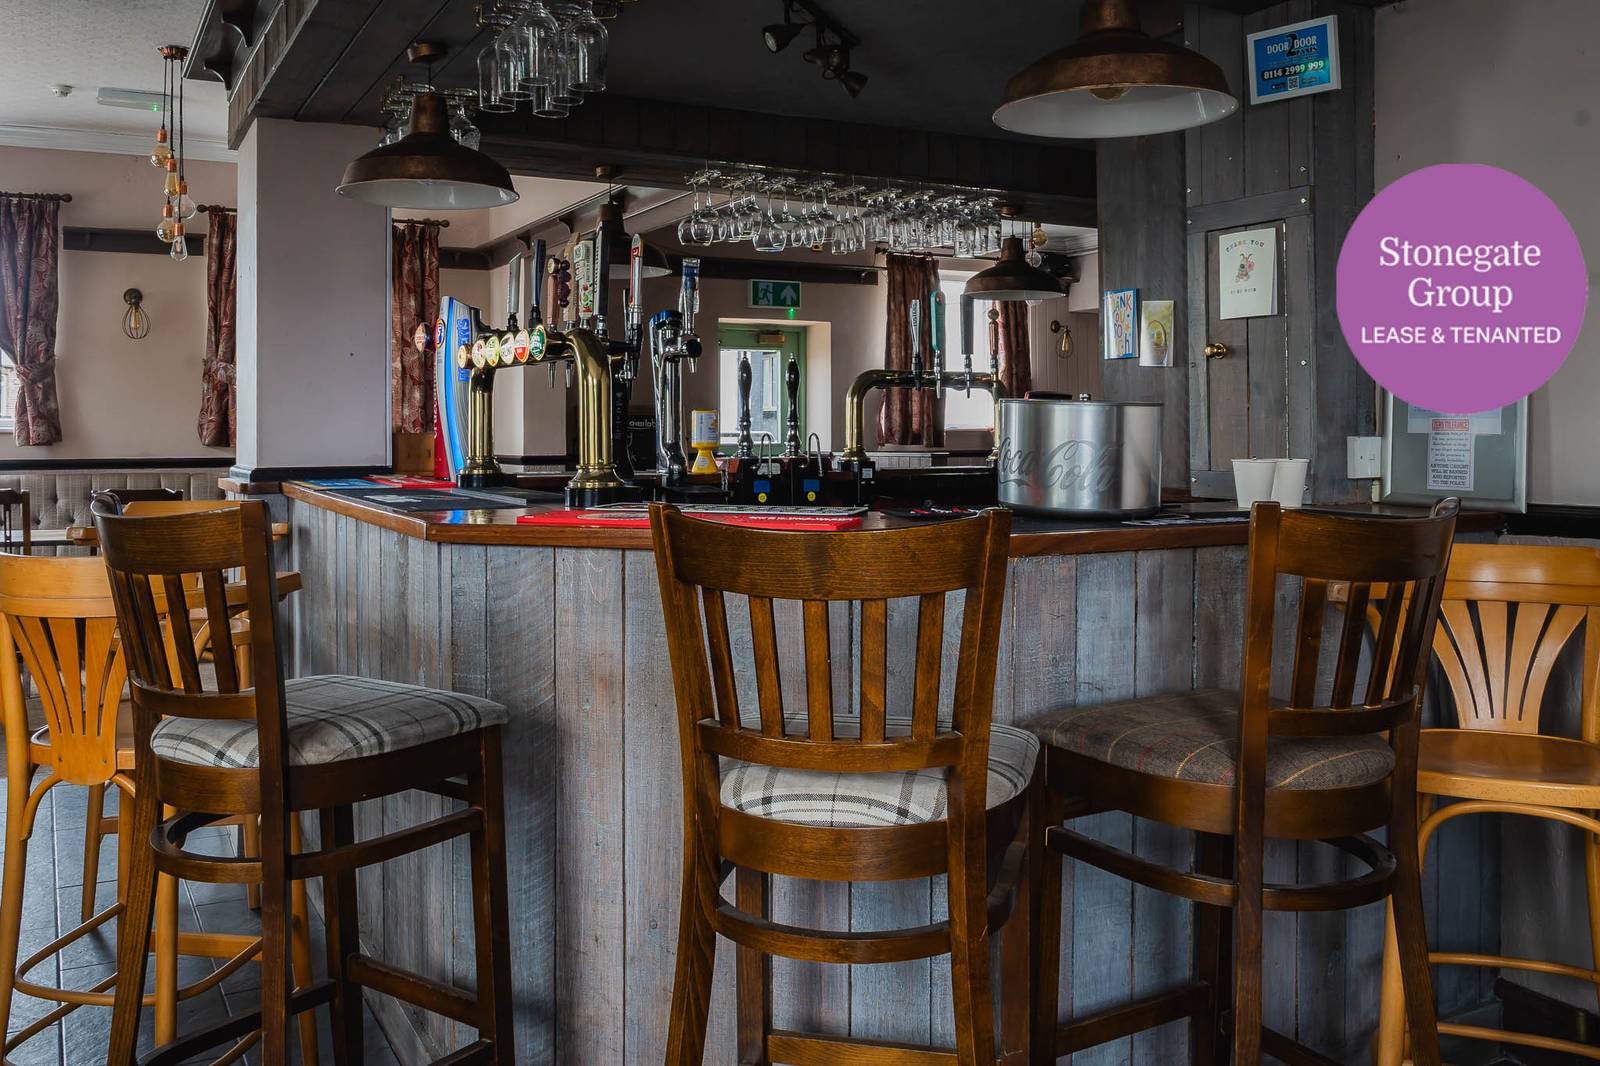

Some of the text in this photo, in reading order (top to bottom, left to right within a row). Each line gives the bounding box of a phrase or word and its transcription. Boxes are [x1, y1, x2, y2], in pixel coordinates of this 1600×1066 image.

[1266, 41, 1289, 55] DOOR
[1294, 35, 1317, 49] DOOR
[1263, 68, 1283, 80] 0114
[1285, 64, 1305, 76] 2999
[1307, 60, 1324, 71] 999
[1046, 440, 1120, 491] Cola
